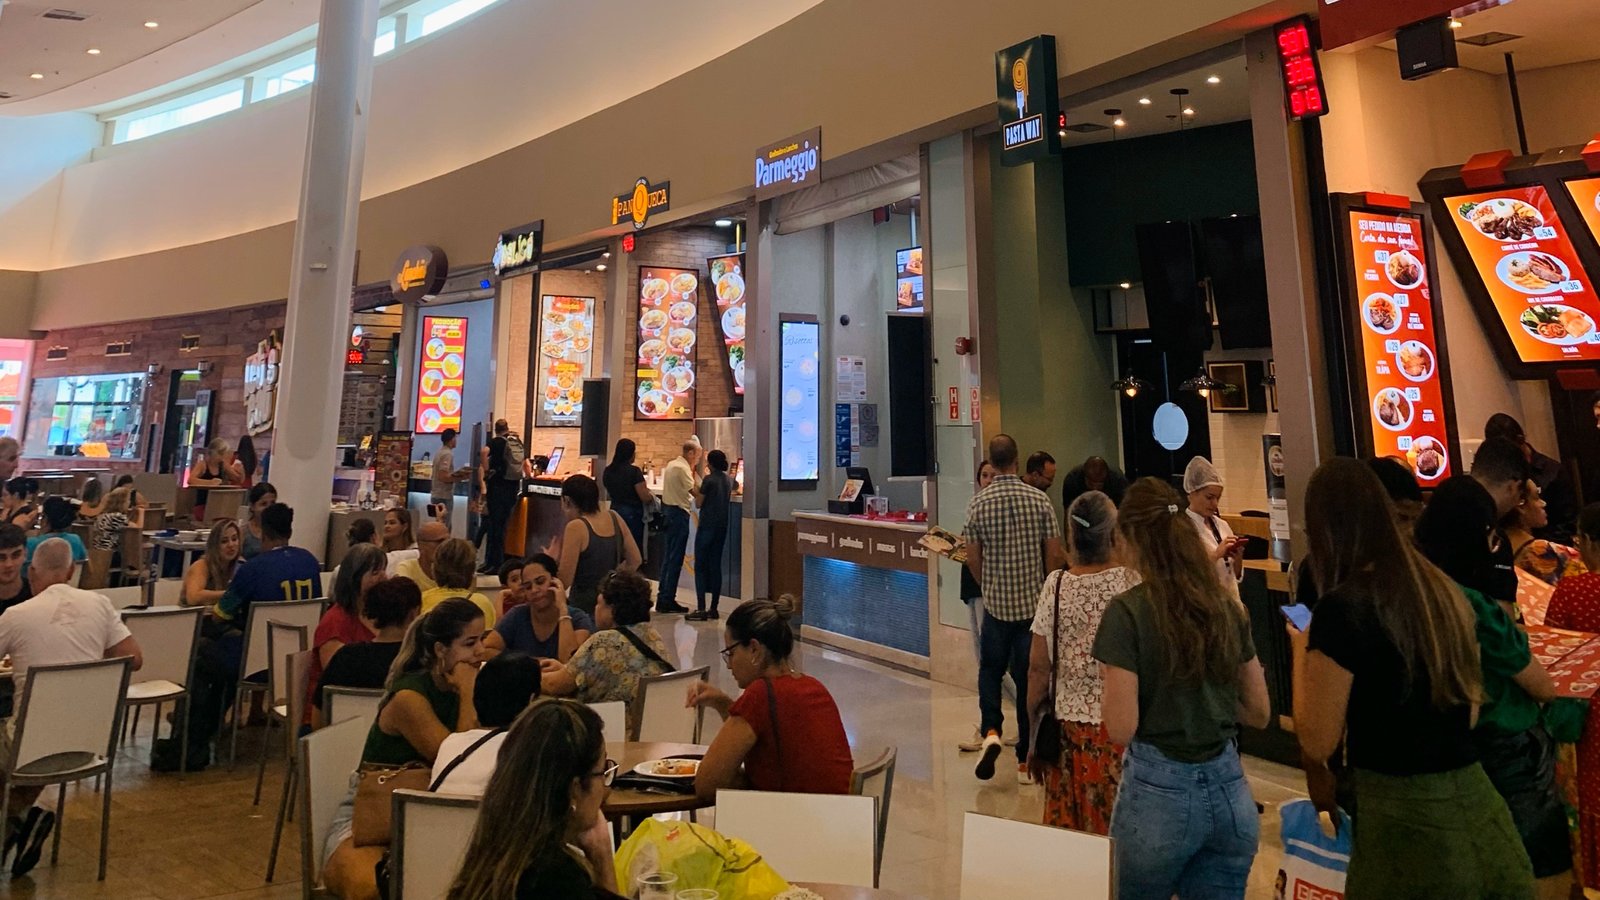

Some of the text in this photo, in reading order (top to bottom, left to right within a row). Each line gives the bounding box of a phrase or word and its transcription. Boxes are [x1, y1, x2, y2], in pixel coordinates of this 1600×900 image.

[1006, 118, 1040, 146] PASTA WAY
[755, 140, 817, 188] Parmeggio
